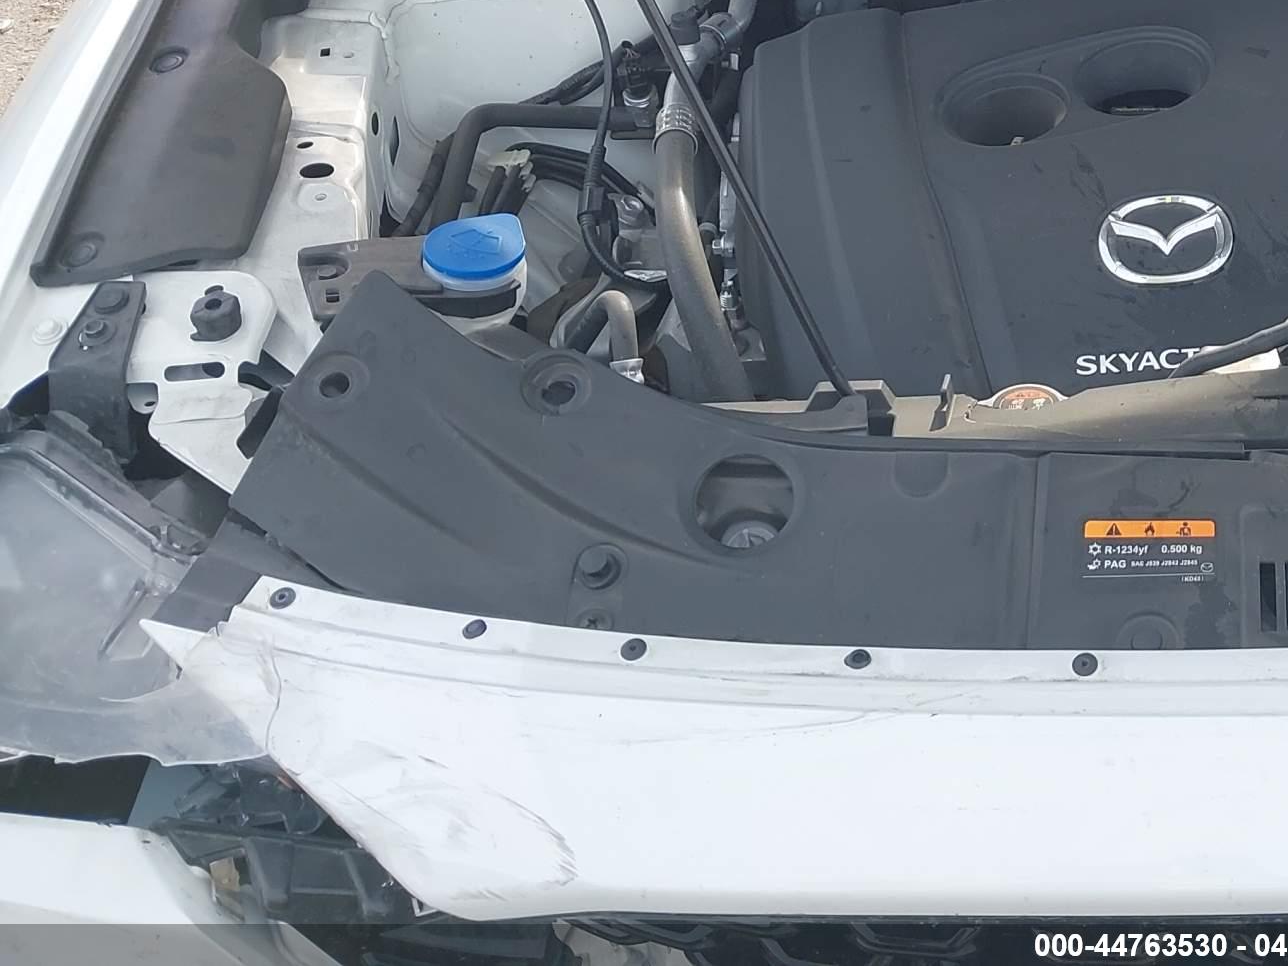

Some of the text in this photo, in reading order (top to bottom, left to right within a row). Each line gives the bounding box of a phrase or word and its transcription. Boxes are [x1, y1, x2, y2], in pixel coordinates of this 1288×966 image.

[1104, 544, 1202, 556] R-1234yf 0.500 kg
[1104, 559, 1127, 569] PAG
